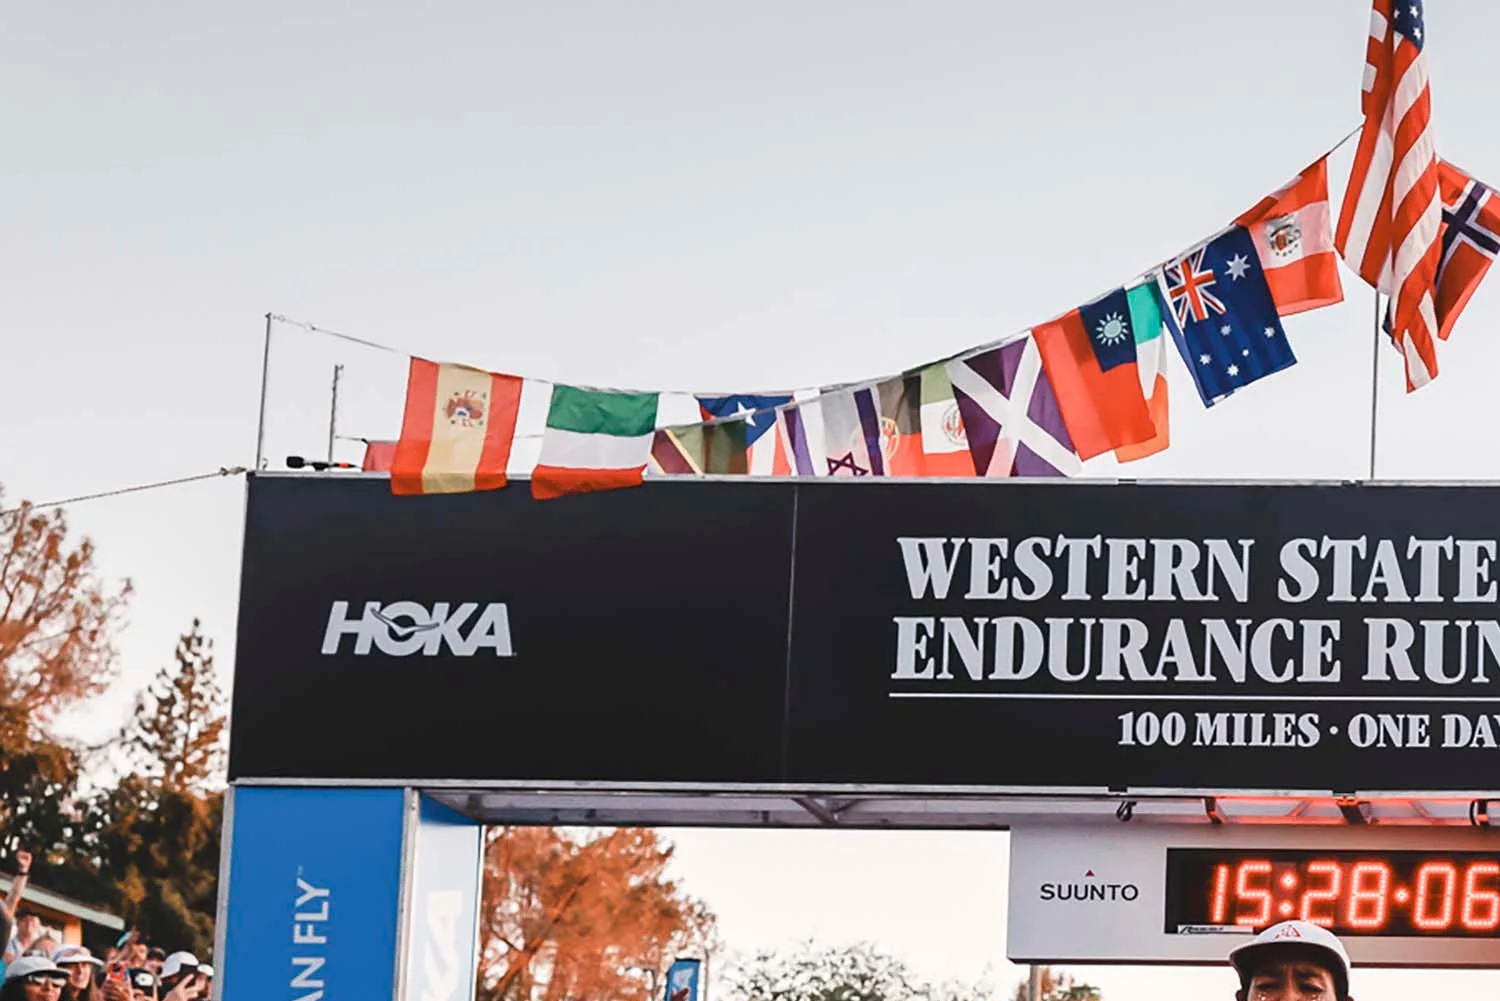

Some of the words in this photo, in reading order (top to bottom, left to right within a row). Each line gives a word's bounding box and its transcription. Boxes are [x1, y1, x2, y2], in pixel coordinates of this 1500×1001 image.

[896, 533, 1254, 602] WESTERN
[320, 601, 514, 656] HOKA
[890, 616, 1342, 682] ENDURANCE
[1117, 712, 1186, 748] 100
[1194, 713, 1320, 748] MILES
[1348, 713, 1430, 749] ONE
[293, 877, 330, 944] FLY
[1040, 883, 1139, 902] SUUNTO
